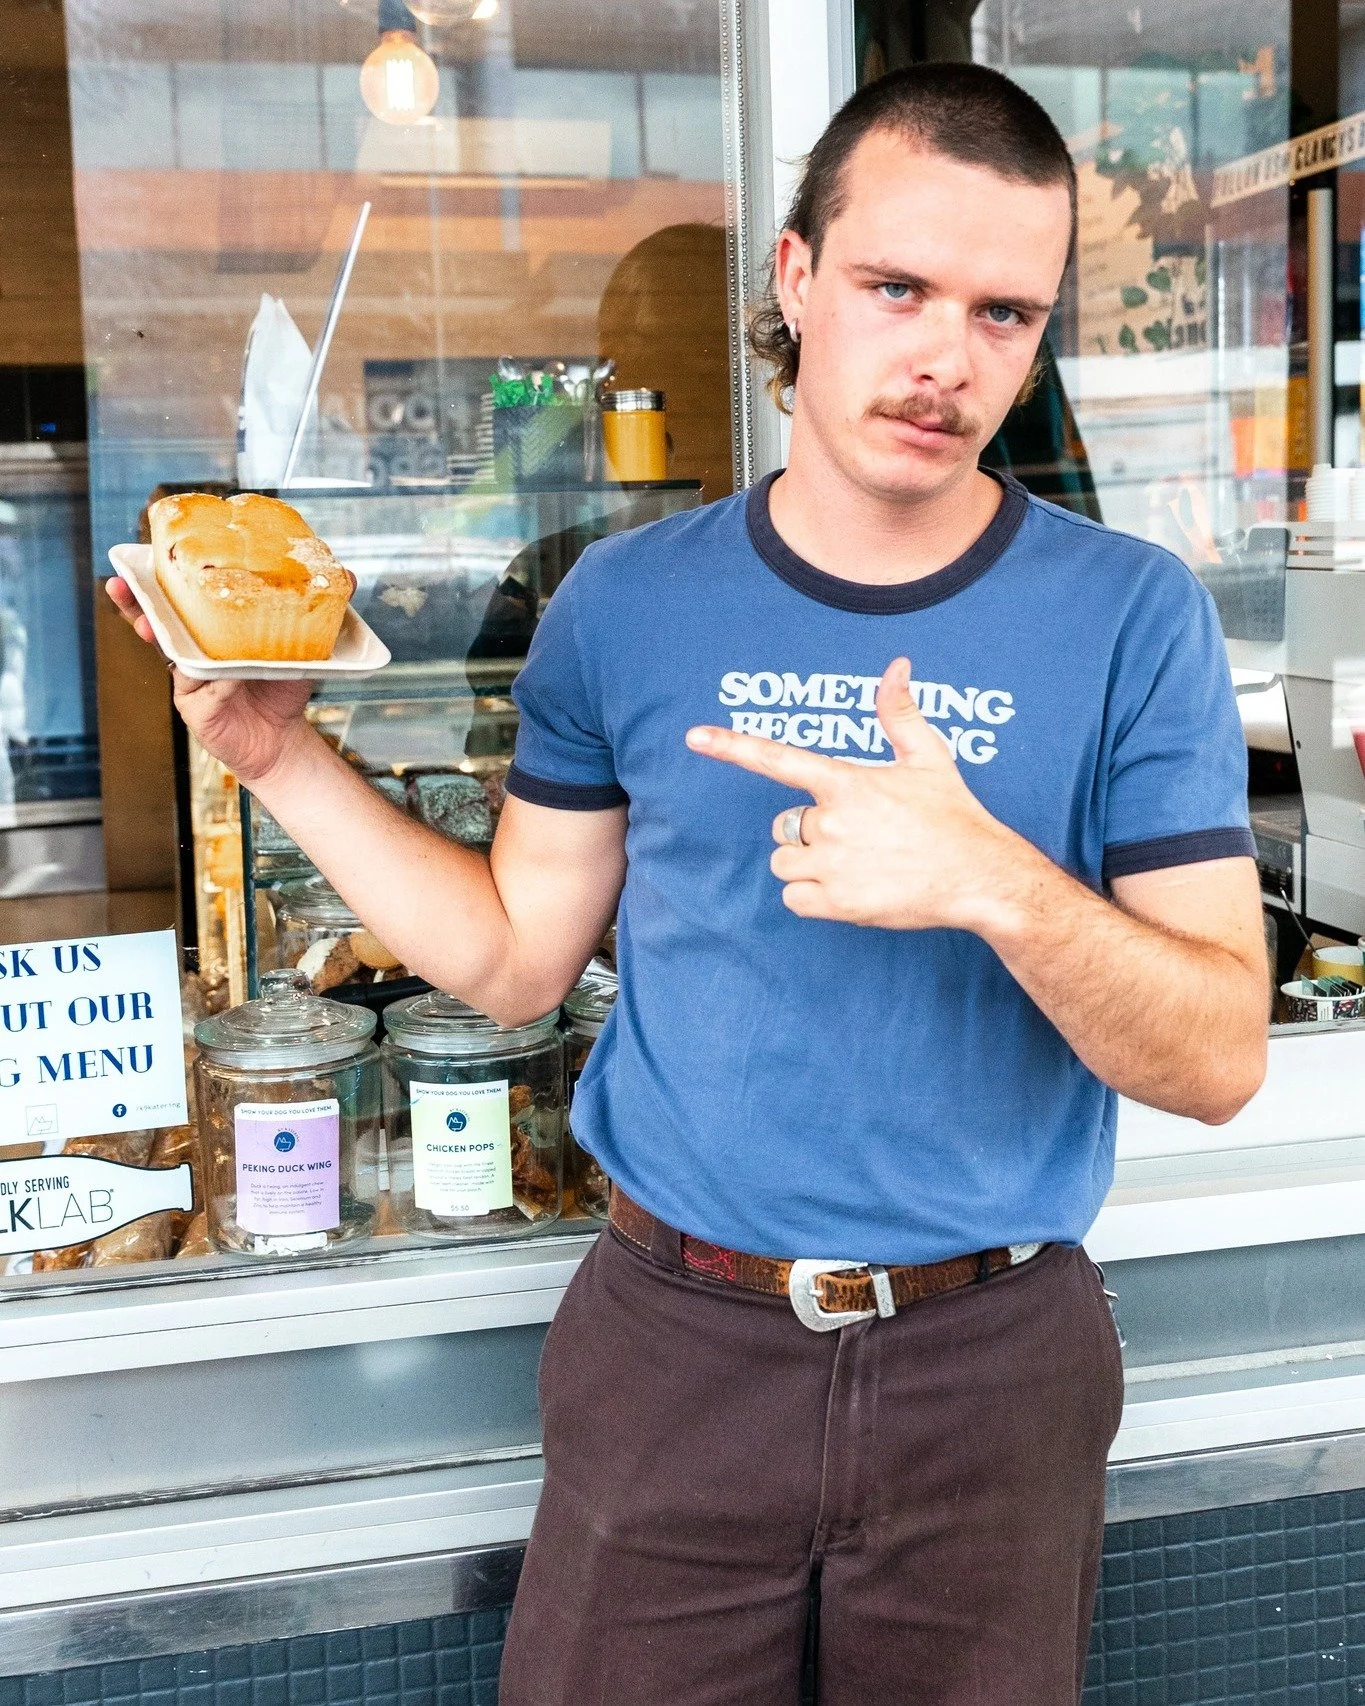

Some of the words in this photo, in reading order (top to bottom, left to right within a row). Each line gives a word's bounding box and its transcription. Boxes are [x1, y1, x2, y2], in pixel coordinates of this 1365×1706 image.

[730, 711, 999, 764] BEGING
[52, 943, 101, 973] US
[0, 1000, 52, 1032] UT
[68, 991, 154, 1026] OUR
[0, 1058, 21, 1087] G
[37, 1044, 154, 1083] MENU
[426, 1143, 466, 1152] CHICKEN
[469, 1143, 495, 1152] POPS
[242, 1163, 275, 1173] PEKING
[278, 1164, 305, 1173] DUCK
[307, 1160, 332, 1171] WING
[0, 1181, 18, 1196] DLY
[25, 1176, 70, 1193] SERVING
